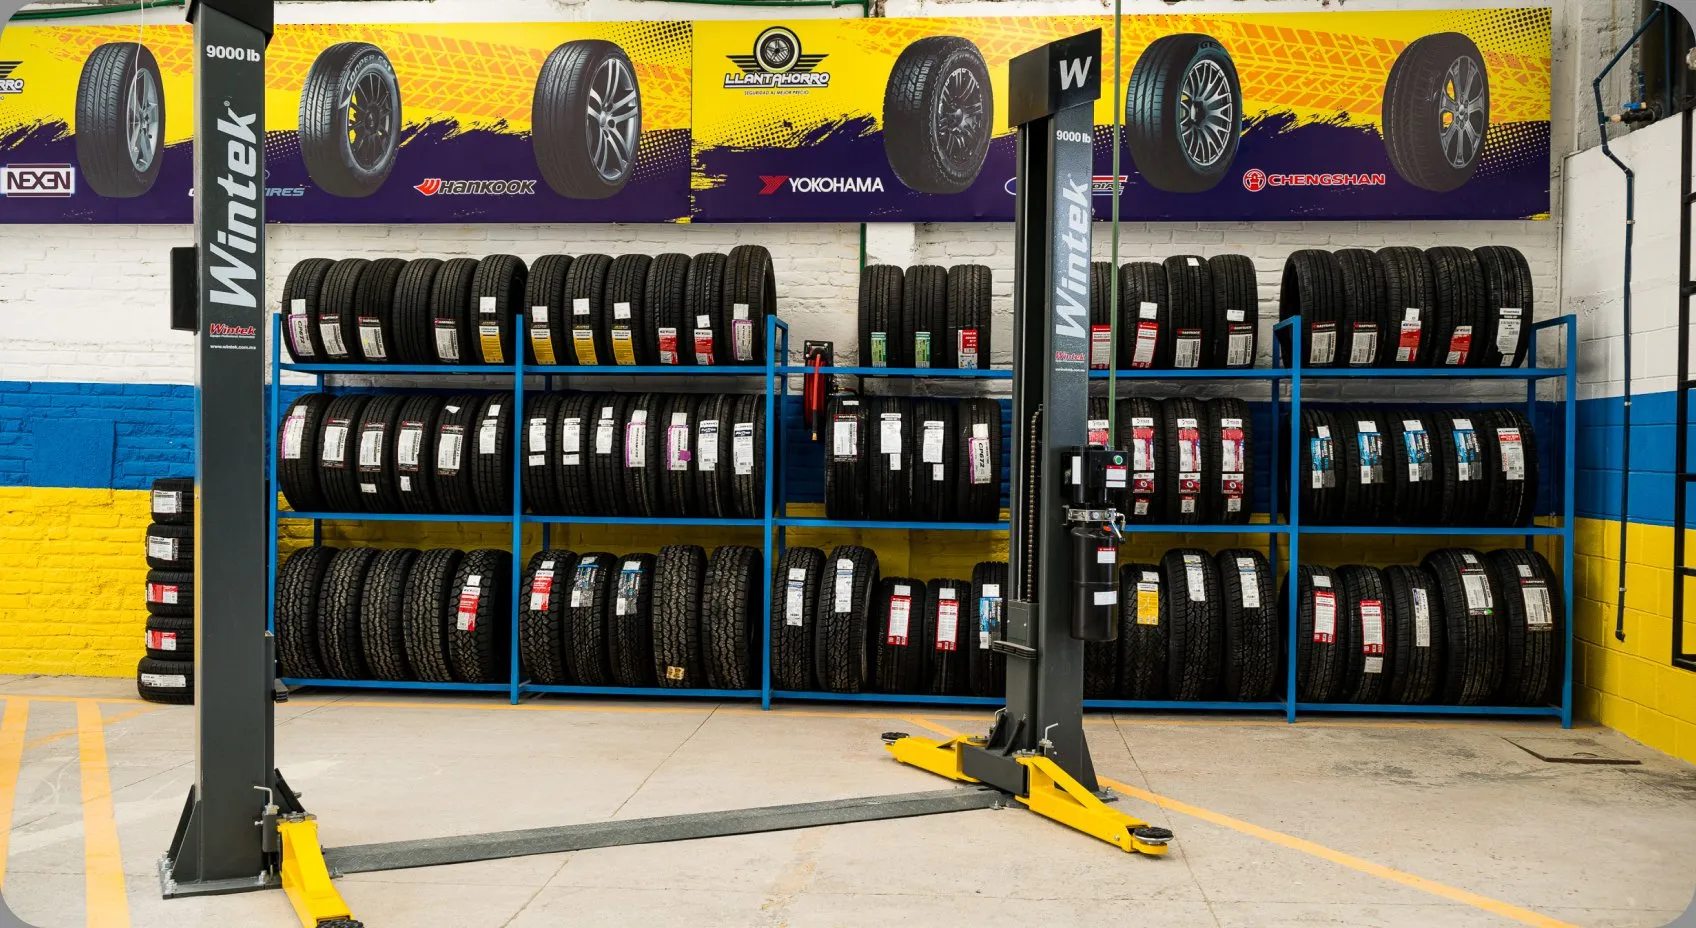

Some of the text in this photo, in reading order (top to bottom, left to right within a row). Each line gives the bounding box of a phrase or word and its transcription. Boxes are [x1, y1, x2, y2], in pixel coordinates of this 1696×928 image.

[206, 44, 260, 62] 9000 lb
[724, 72, 830, 88] LLANTAHORRO
[1060, 55, 1092, 90] W
[1056, 130, 1092, 144] 9000 lb
[7, 171, 71, 190] NEXEN
[789, 177, 885, 193] YOKOHAMA
[1267, 174, 1386, 186] CHENGSHAN
[209, 107, 257, 308] Wintek
[1055, 178, 1089, 339] Wintek
[209, 323, 256, 335] Wintek
[1055, 351, 1085, 361] Wintek
